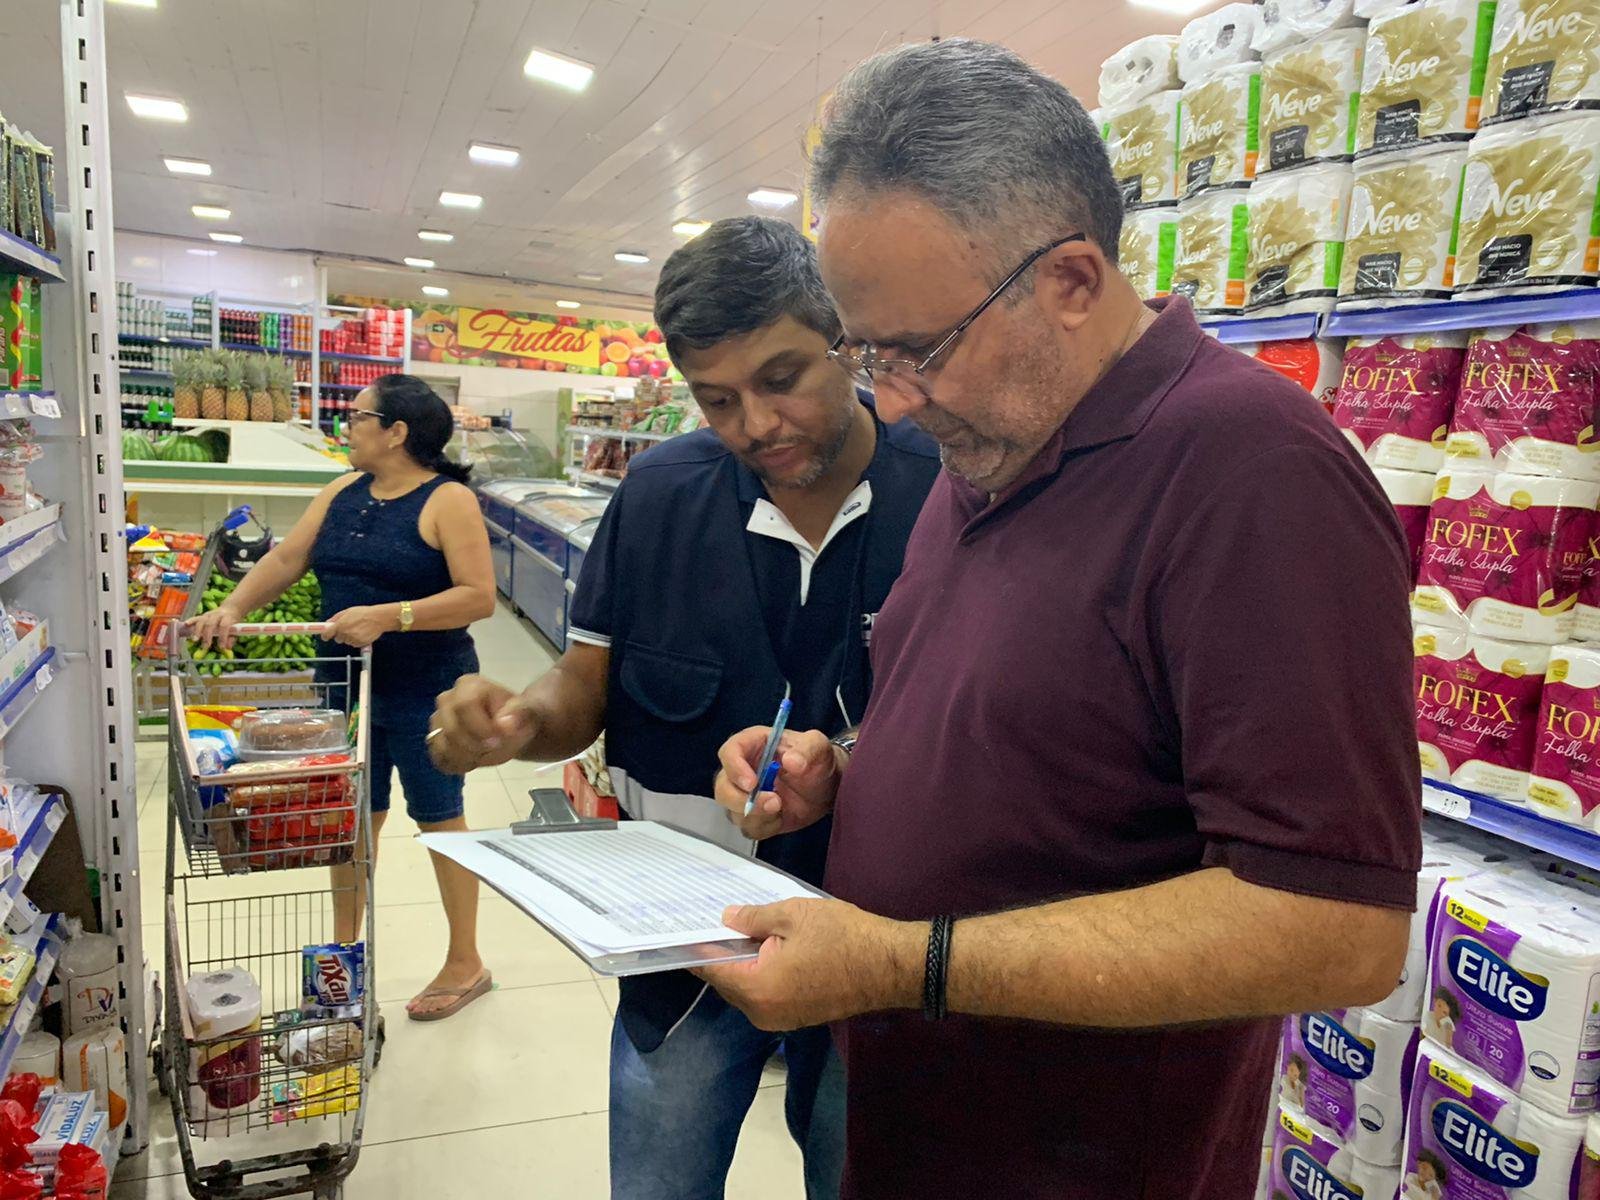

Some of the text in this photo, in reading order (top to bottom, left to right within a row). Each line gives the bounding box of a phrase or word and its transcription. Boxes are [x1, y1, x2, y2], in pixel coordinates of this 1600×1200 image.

[1503, 4, 1582, 46] Neve
[1374, 49, 1440, 87] Neve
[1265, 88, 1322, 122] Neve
[1114, 132, 1153, 164] Neve
[1183, 114, 1223, 148] Neve
[1485, 178, 1557, 218] Neve
[1363, 201, 1422, 236] Neve
[1117, 255, 1138, 275] eve
[1249, 234, 1297, 267] Neve
[447, 308, 593, 359] Frutas
[1341, 363, 1421, 393] FOFEX
[1465, 362, 1563, 393] FOFEX
[1337, 389, 1369, 410] Folha
[1373, 390, 1415, 418] Dupla
[1462, 388, 1558, 420] Folha Dupla
[1430, 517, 1523, 556] FOFEX
[1426, 543, 1517, 580] Folha Dupla
[1417, 674, 1517, 723] FOFEX
[1416, 699, 1457, 727] Folha
[1461, 714, 1513, 744] Dupla
[1542, 731, 1592, 763] Folha
[1451, 903, 1465, 920] 12
[1457, 946, 1534, 1013] Elite
[1465, 1001, 1487, 1018] Ultra
[1487, 1014, 1514, 1036] Suave
[1307, 1015, 1366, 1073] Elite
[1489, 1045, 1503, 1060] 20
[1433, 1065, 1449, 1083] 12
[56, 1100, 83, 1140] VIDALUZ
[1283, 1117, 1295, 1132] 12
[1326, 1102, 1340, 1114] 20
[1443, 1109, 1525, 1180] Elite
[1289, 1155, 1350, 1200] Elit
